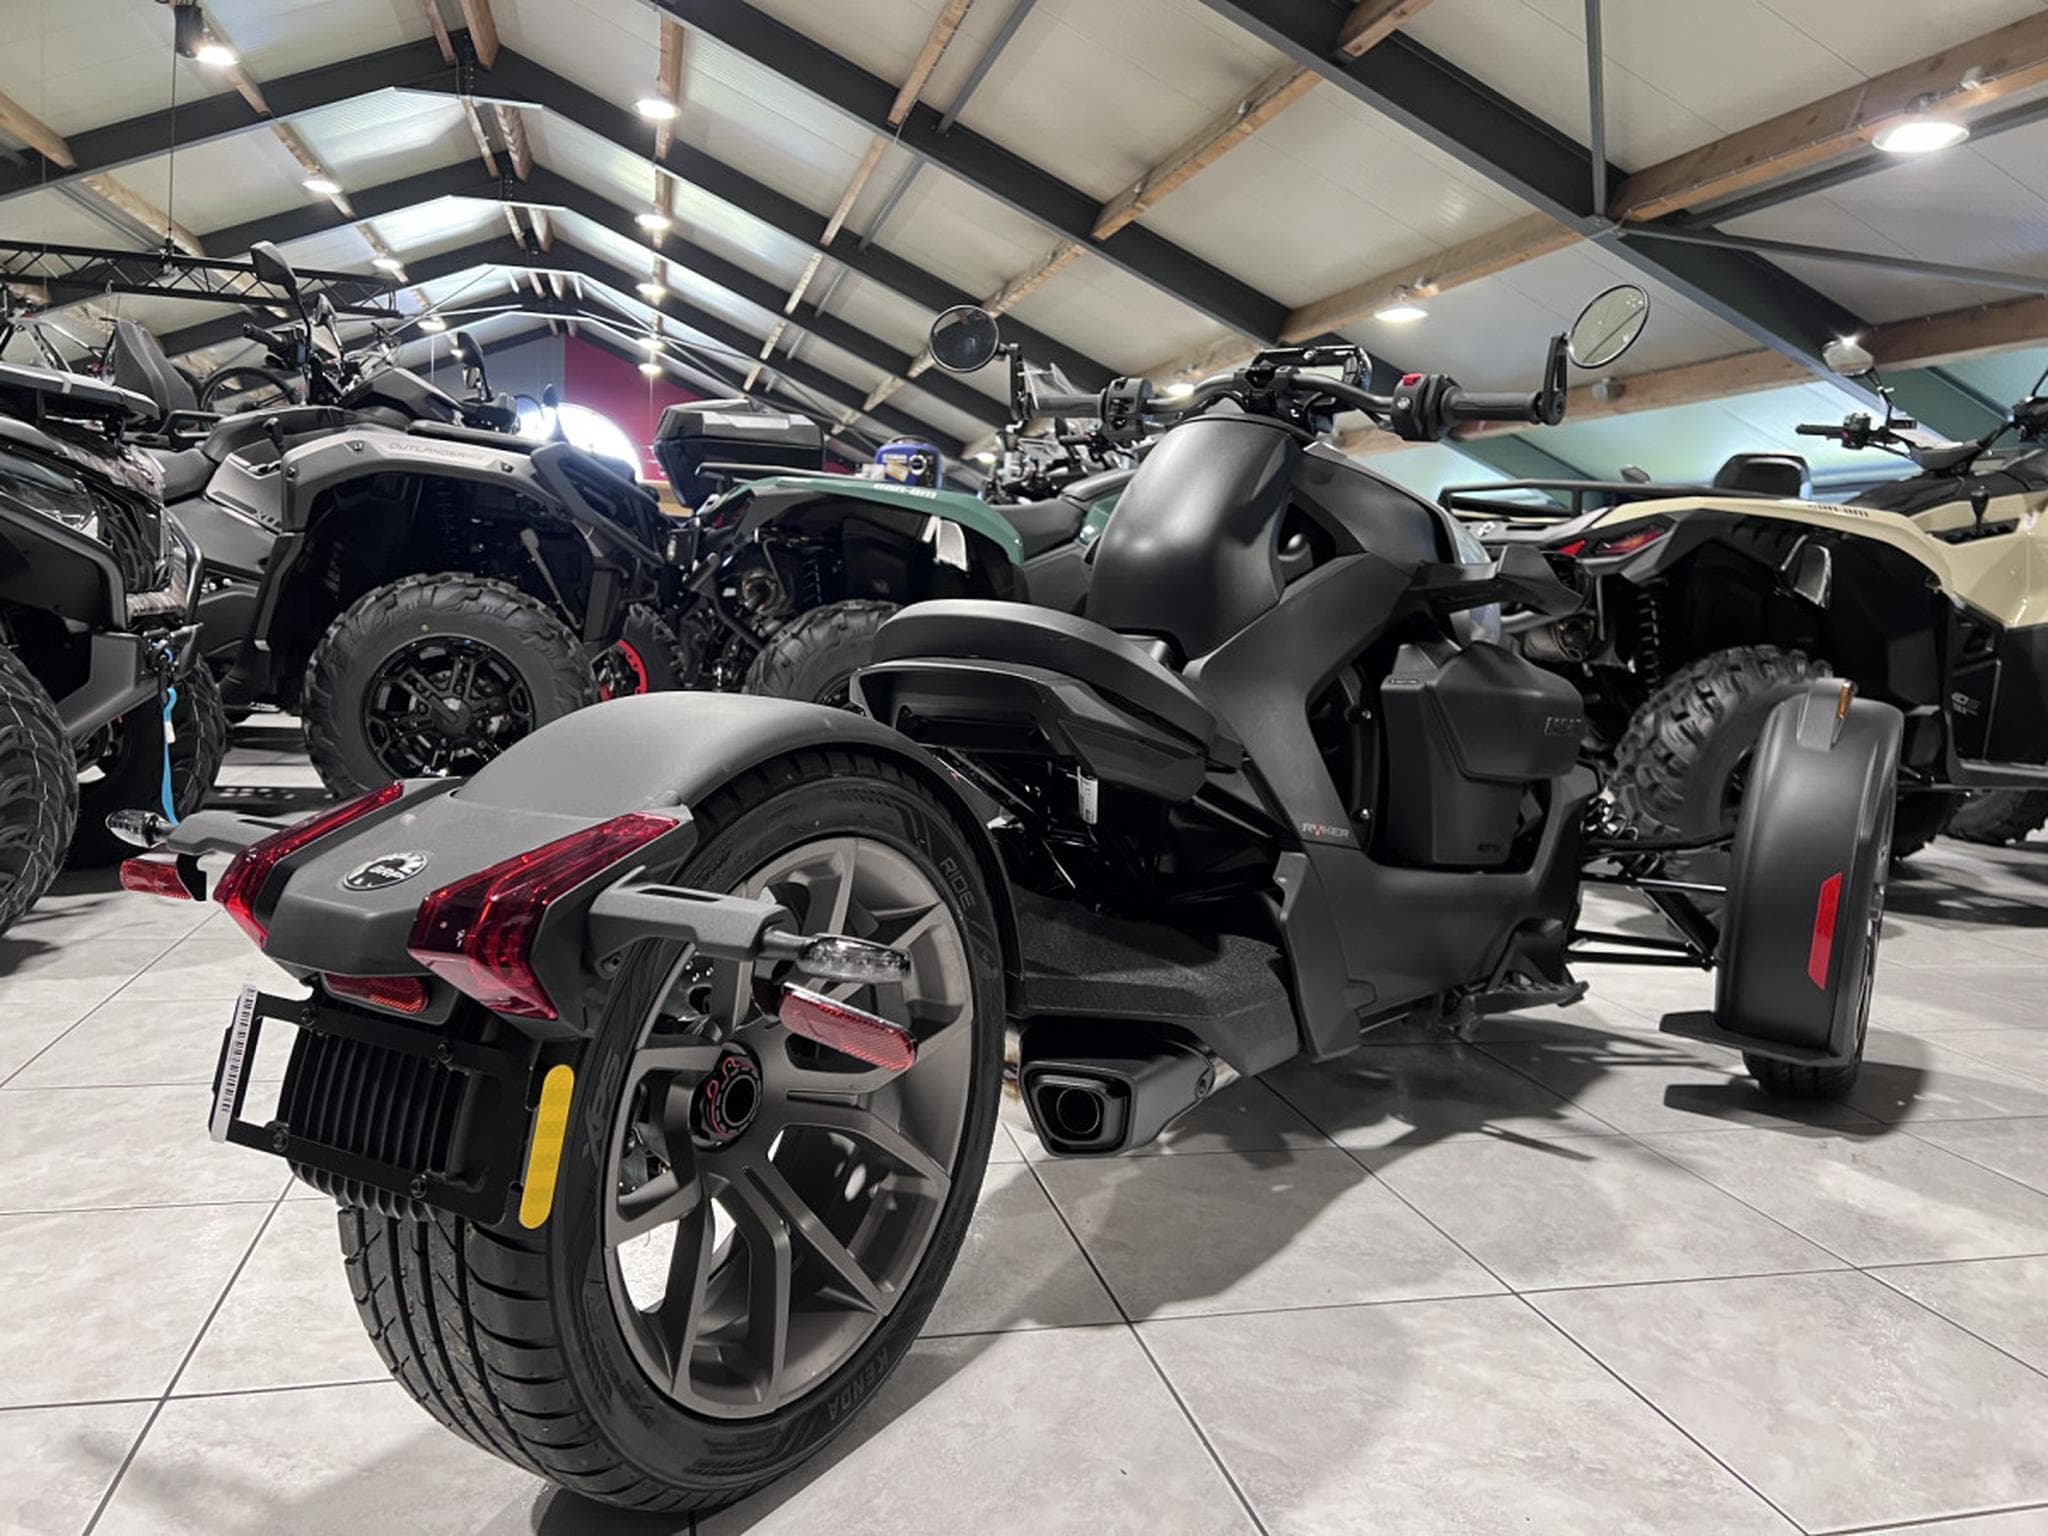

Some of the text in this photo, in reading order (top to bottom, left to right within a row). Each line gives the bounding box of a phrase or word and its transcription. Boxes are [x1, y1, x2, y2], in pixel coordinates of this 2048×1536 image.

[1302, 823, 1349, 840] RYKER
[940, 856, 976, 911] RIDE
[827, 1346, 890, 1420] KENDA
